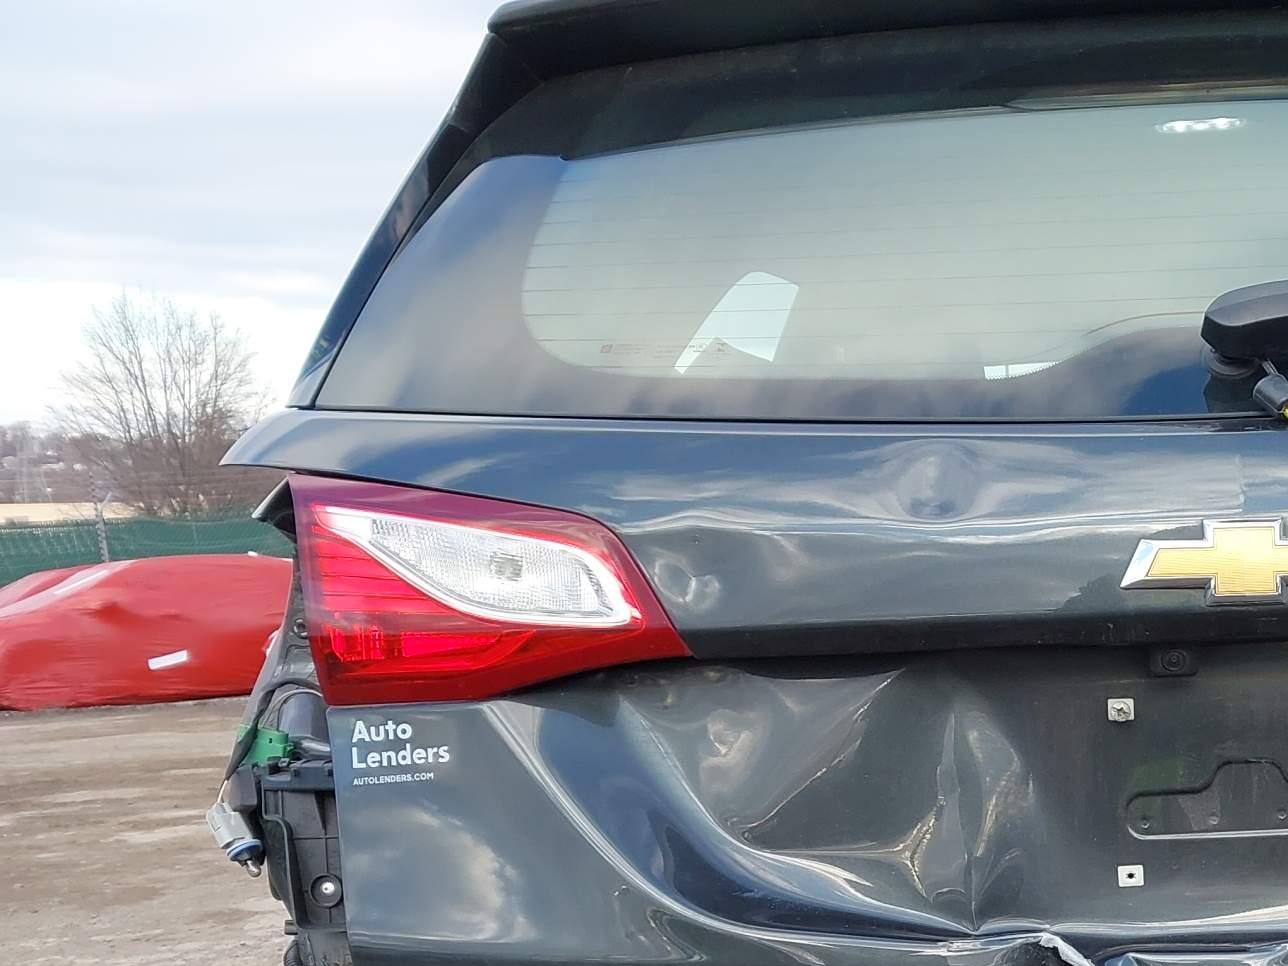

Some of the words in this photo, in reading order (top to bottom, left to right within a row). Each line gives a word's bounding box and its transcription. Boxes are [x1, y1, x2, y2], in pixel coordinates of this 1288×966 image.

[352, 720, 412, 742] Auto
[352, 743, 450, 769] Lenders
[353, 772, 434, 786] AUTOLENDERS.COM
